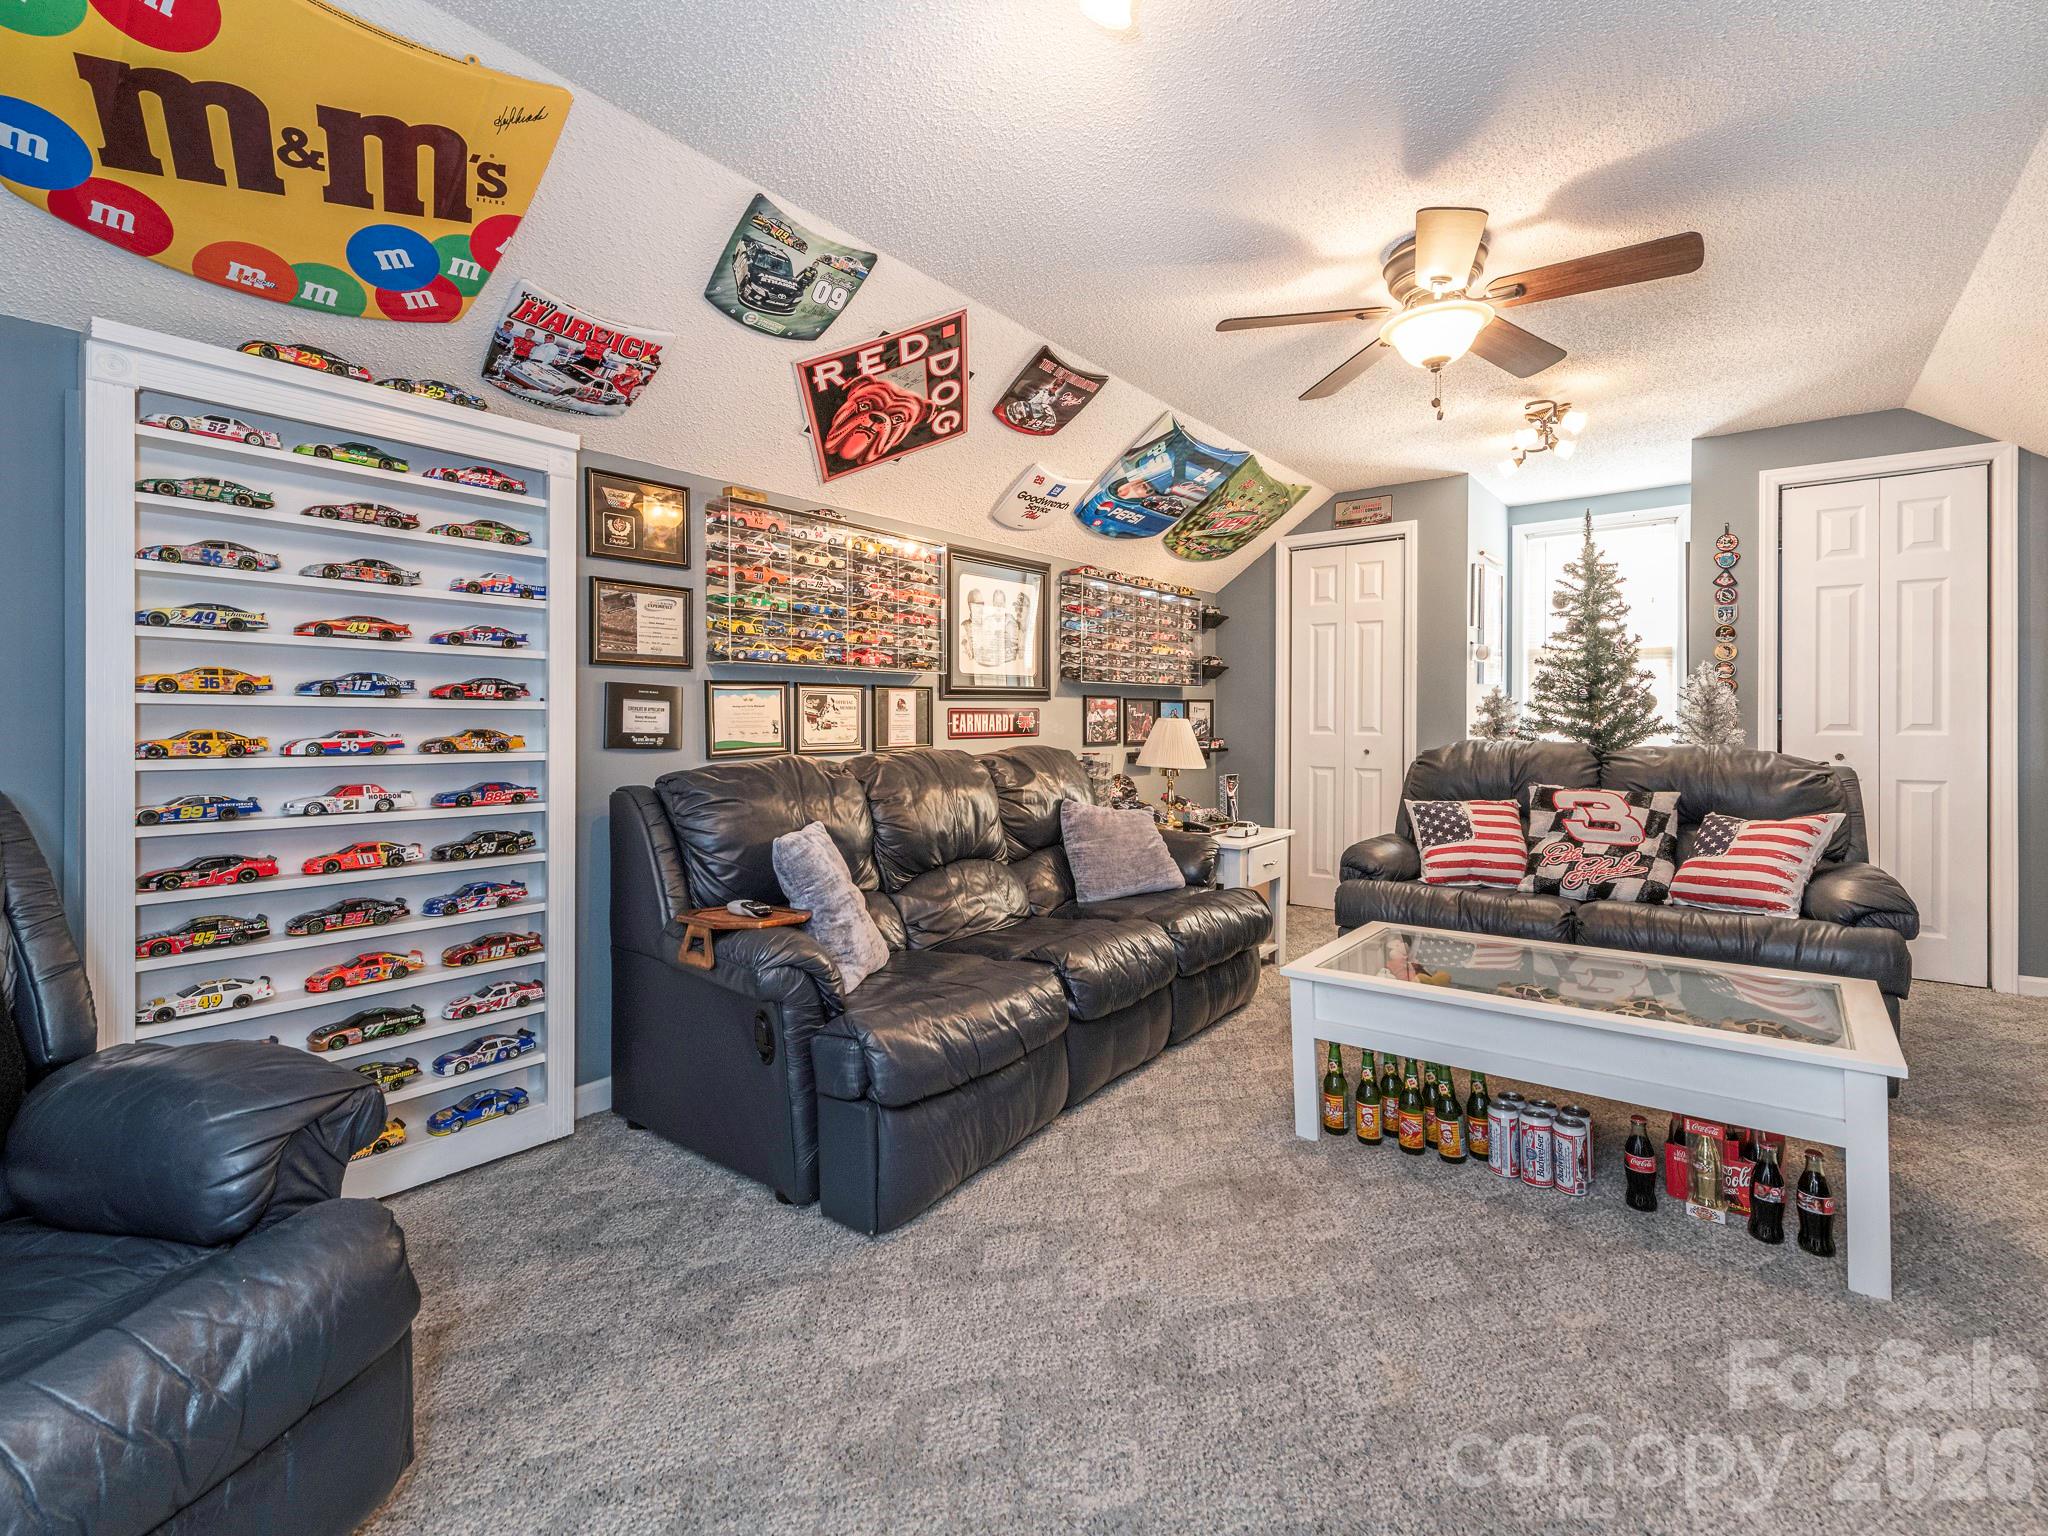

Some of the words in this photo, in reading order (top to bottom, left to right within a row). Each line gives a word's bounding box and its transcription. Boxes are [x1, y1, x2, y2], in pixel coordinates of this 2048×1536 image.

[0, 121, 49, 163] m
[476, 197, 506, 206] BRAND
[88, 200, 136, 234] m
[776, 228, 790, 241] 09
[373, 248, 414, 271] m
[225, 261, 267, 290] m
[447, 257, 481, 281] m
[300, 281, 339, 307] m
[401, 290, 438, 310] m
[520, 291, 559, 311] Kevin
[812, 280, 849, 311] 09
[298, 352, 321, 366] 25
[813, 333, 930, 392] RED
[428, 386, 445, 398] 25
[928, 347, 960, 435] DOG
[208, 422, 229, 434] 52
[470, 472, 491, 484] 25
[1033, 475, 1046, 486] 29
[195, 484, 222, 498] 33
[224, 486, 260, 496] SKOAL
[1017, 490, 1070, 510] Goodwrench
[1025, 503, 1051, 514] Service
[1108, 507, 1146, 525] PEPSI
[201, 548, 223, 564] 36
[494, 582, 512, 592] 52
[190, 610, 217, 625] 49
[346, 623, 370, 634] 49
[476, 632, 493, 642] 52
[198, 676, 220, 690] 36
[354, 680, 372, 691] 15
[478, 684, 496, 695] 49
[952, 713, 1014, 733] EARNHARDT
[188, 740, 212, 754] 36
[340, 740, 359, 752] 36
[484, 790, 504, 802] 88
[343, 799, 360, 810] 21
[180, 806, 204, 819] 99
[1552, 789, 1646, 846] 3
[480, 842, 498, 854] 39
[1542, 841, 1584, 868] Dale
[356, 852, 374, 864] 10
[206, 869, 219, 884] 1
[1561, 850, 1649, 890] Earnhardt
[343, 912, 366, 925] 26
[193, 930, 218, 946] 95
[490, 944, 506, 958] 18
[363, 966, 380, 979] 32
[198, 994, 223, 1009] 49
[364, 1022, 387, 1038] 97
[384, 1068, 417, 1082] Havoline
[480, 1104, 497, 1119] 94
[1536, 1134, 1545, 1178] Budweiser
